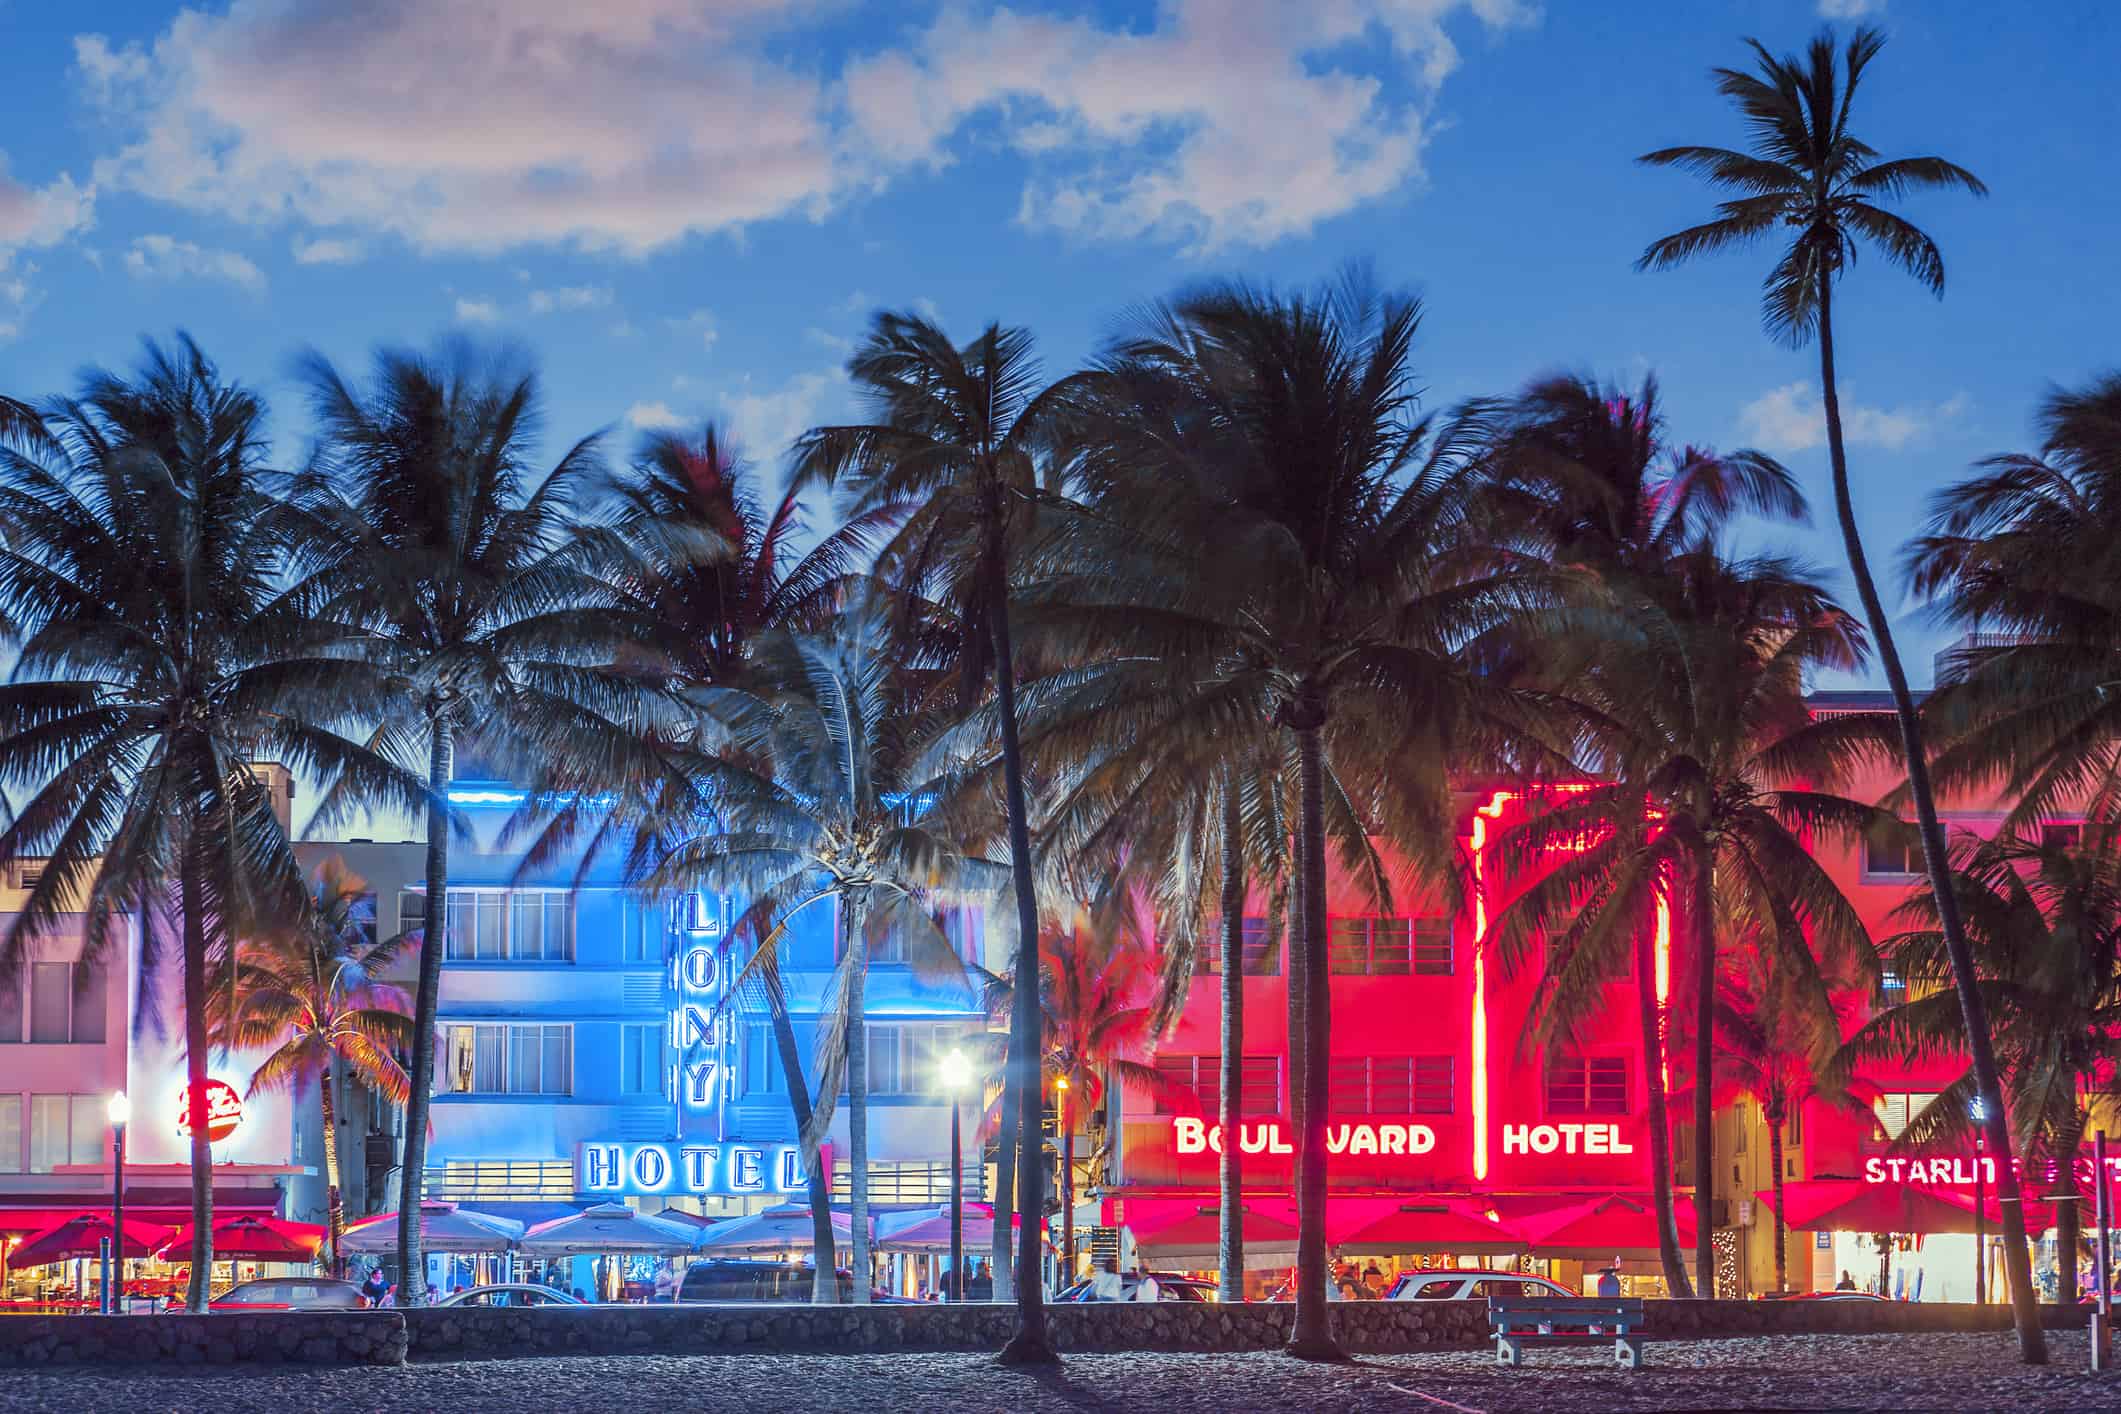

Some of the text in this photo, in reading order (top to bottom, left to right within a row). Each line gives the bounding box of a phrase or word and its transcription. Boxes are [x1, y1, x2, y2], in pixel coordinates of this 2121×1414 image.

[685, 780, 717, 1101] LONY
[1174, 1117, 1633, 1154] BULVARD HOTEL
[588, 1148, 810, 1189] HOTEL
[1865, 1158, 2021, 1184] STARLIT
